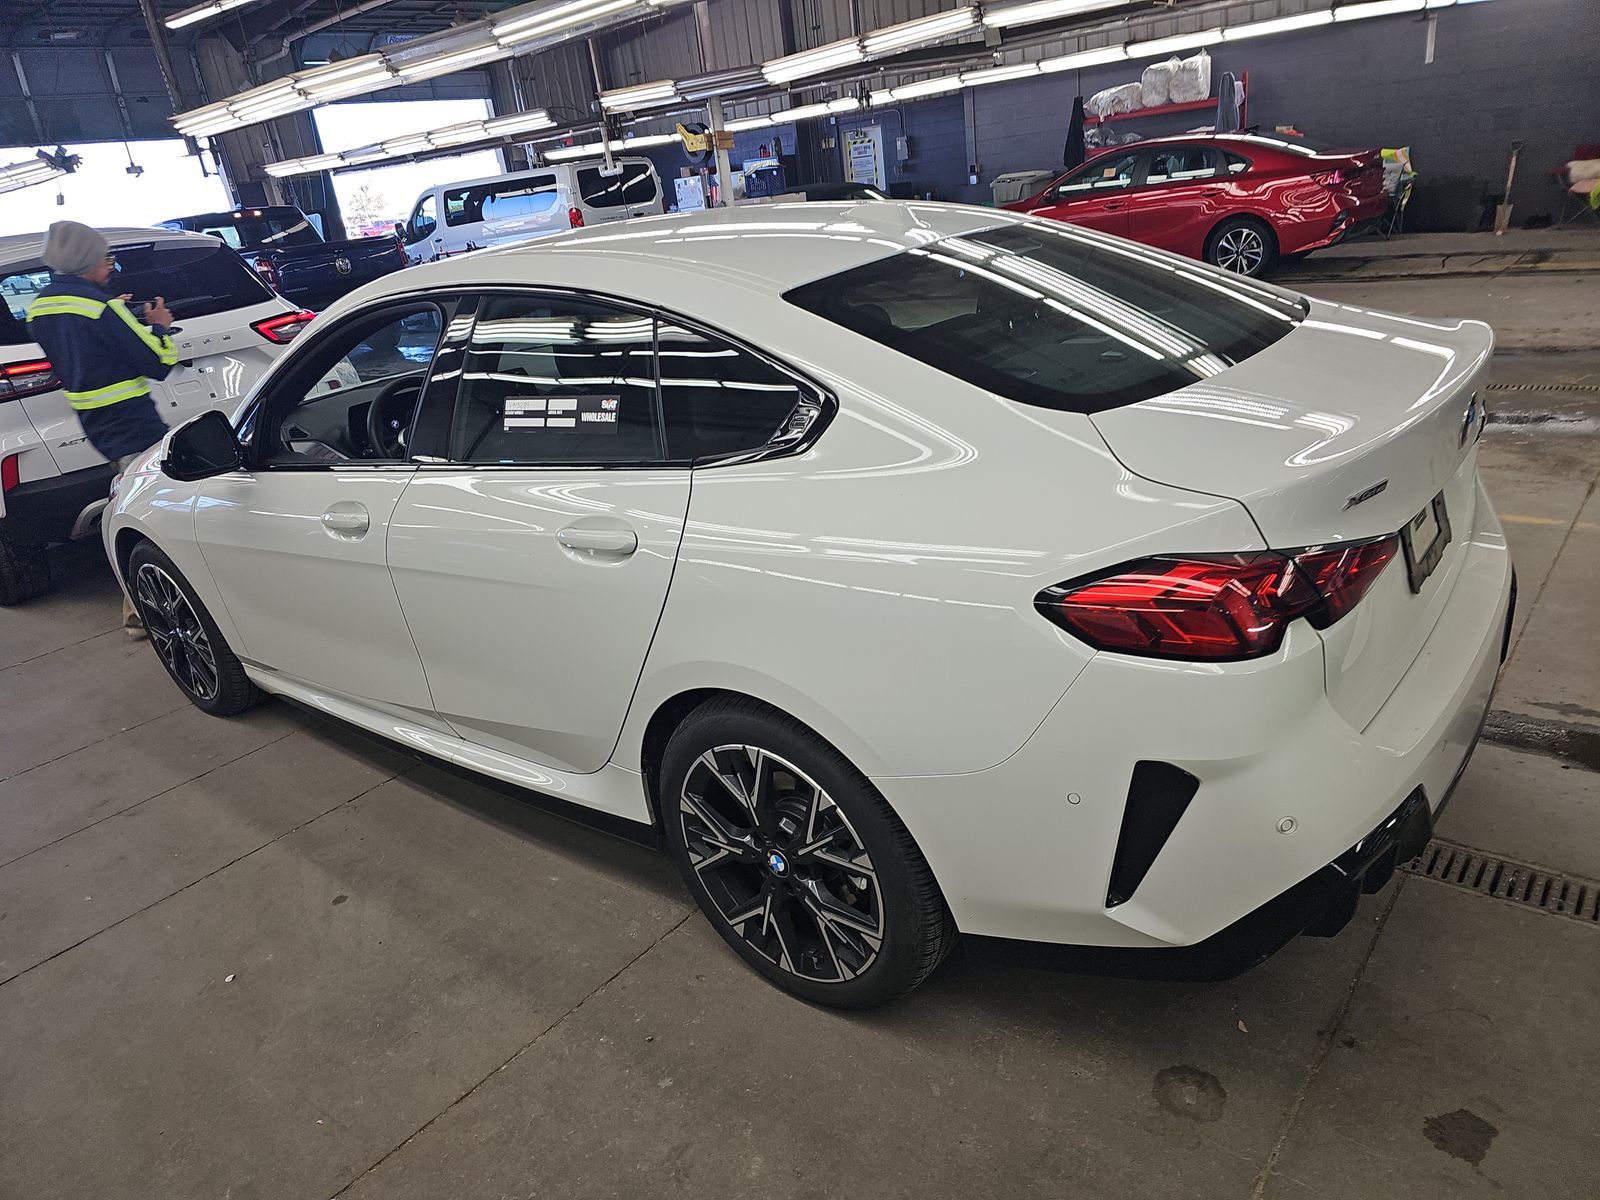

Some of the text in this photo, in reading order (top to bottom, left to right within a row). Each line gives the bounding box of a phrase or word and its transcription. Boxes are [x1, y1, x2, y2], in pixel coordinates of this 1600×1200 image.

[601, 399, 617, 410] SIXT
[581, 411, 616, 422] WHOLESALE
[58, 436, 89, 448] ACT
